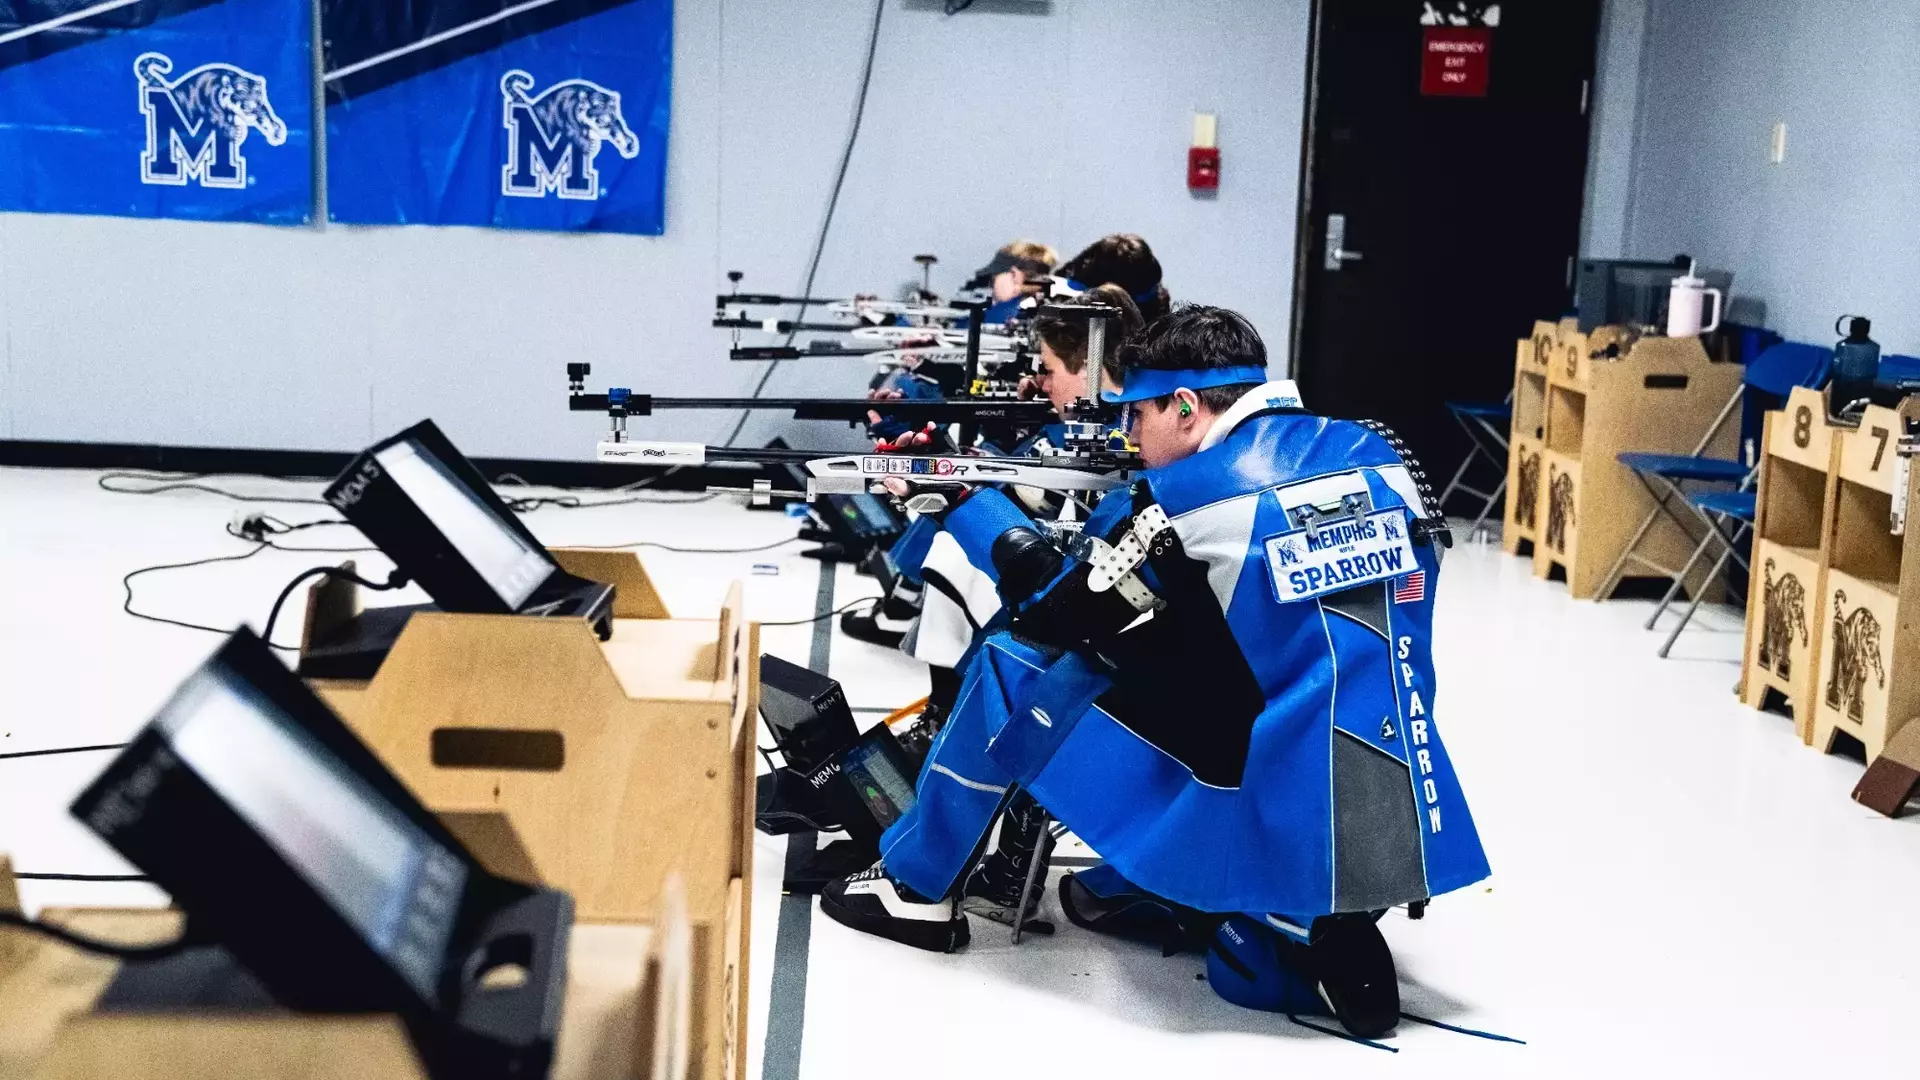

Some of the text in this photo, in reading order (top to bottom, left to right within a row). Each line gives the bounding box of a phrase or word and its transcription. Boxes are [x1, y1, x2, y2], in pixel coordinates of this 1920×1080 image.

[1428, 40, 1485, 53] EMERGENCY
[1444, 56, 1466, 67] EXIT
[1442, 72, 1467, 83] ONLY
[140, 83, 246, 189] M
[502, 100, 599, 200] M
[1566, 344, 1579, 380] 9
[1794, 405, 1812, 449] 8
[1870, 425, 1889, 472] 7
[1306, 519, 1377, 553] MEMPHIS
[1289, 546, 1403, 594] SPARROW
[816, 690, 844, 714] MEM 7
[1397, 635, 1442, 834] SPARROW
[810, 762, 842, 790] MEM 6
